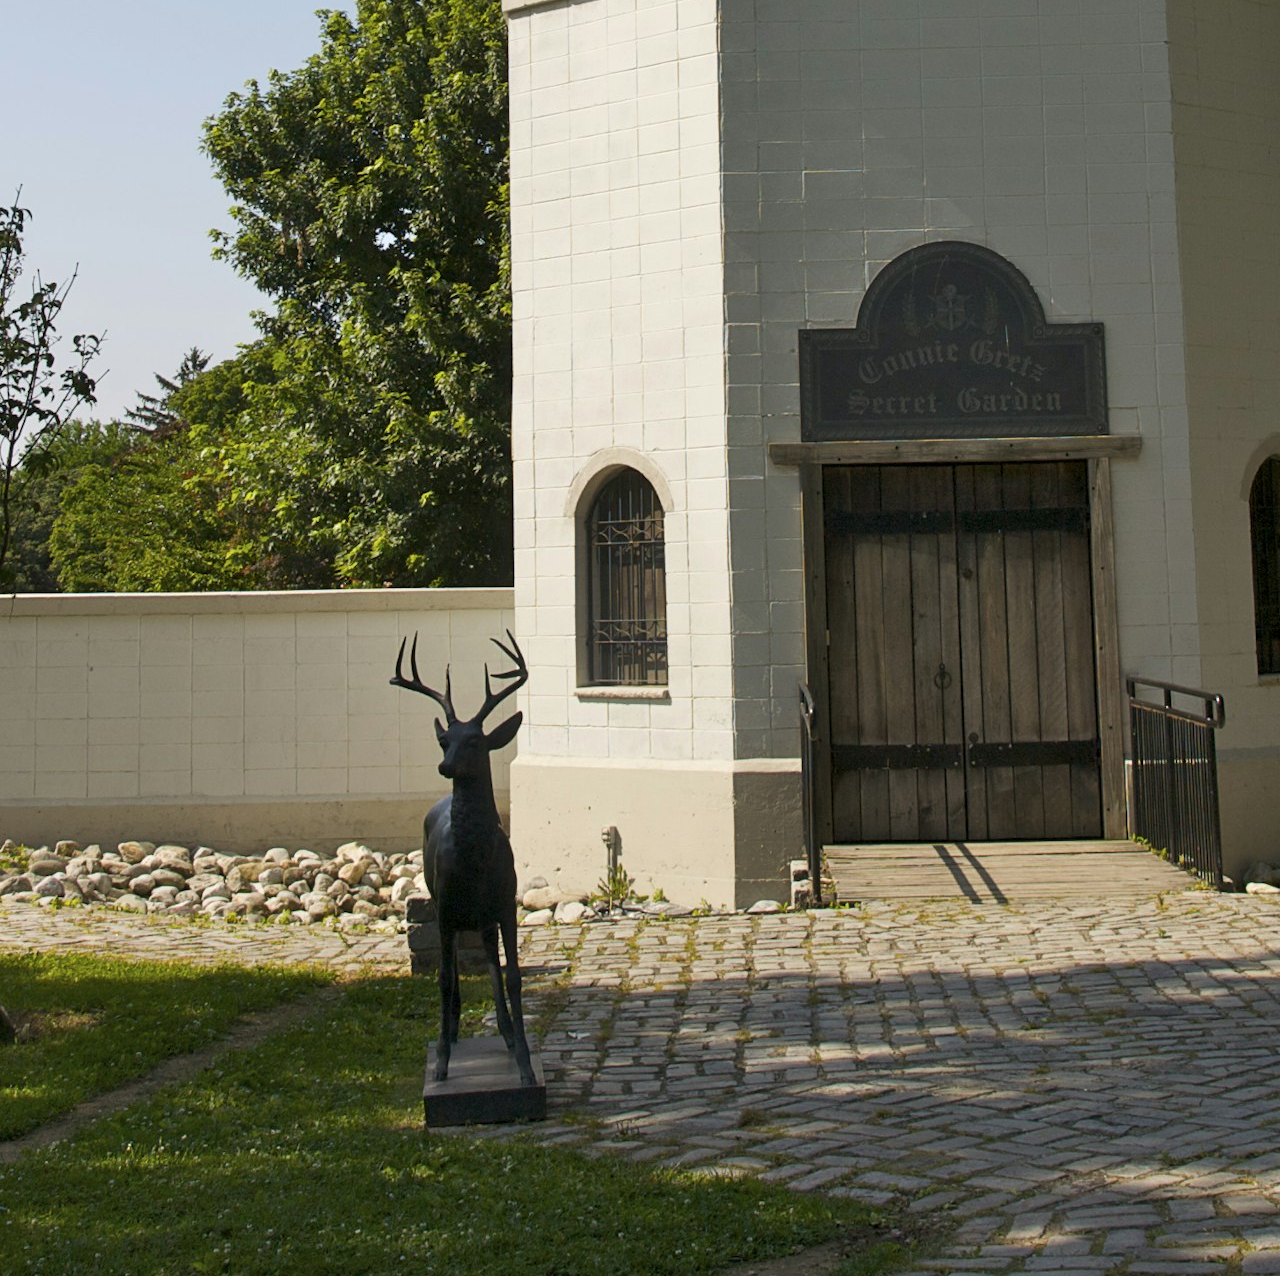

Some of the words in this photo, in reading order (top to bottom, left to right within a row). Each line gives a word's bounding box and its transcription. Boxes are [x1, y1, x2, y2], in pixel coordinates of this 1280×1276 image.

[858, 340, 959, 384] Connie
[847, 389, 937, 415] Secret
[957, 387, 1062, 413] Garden
